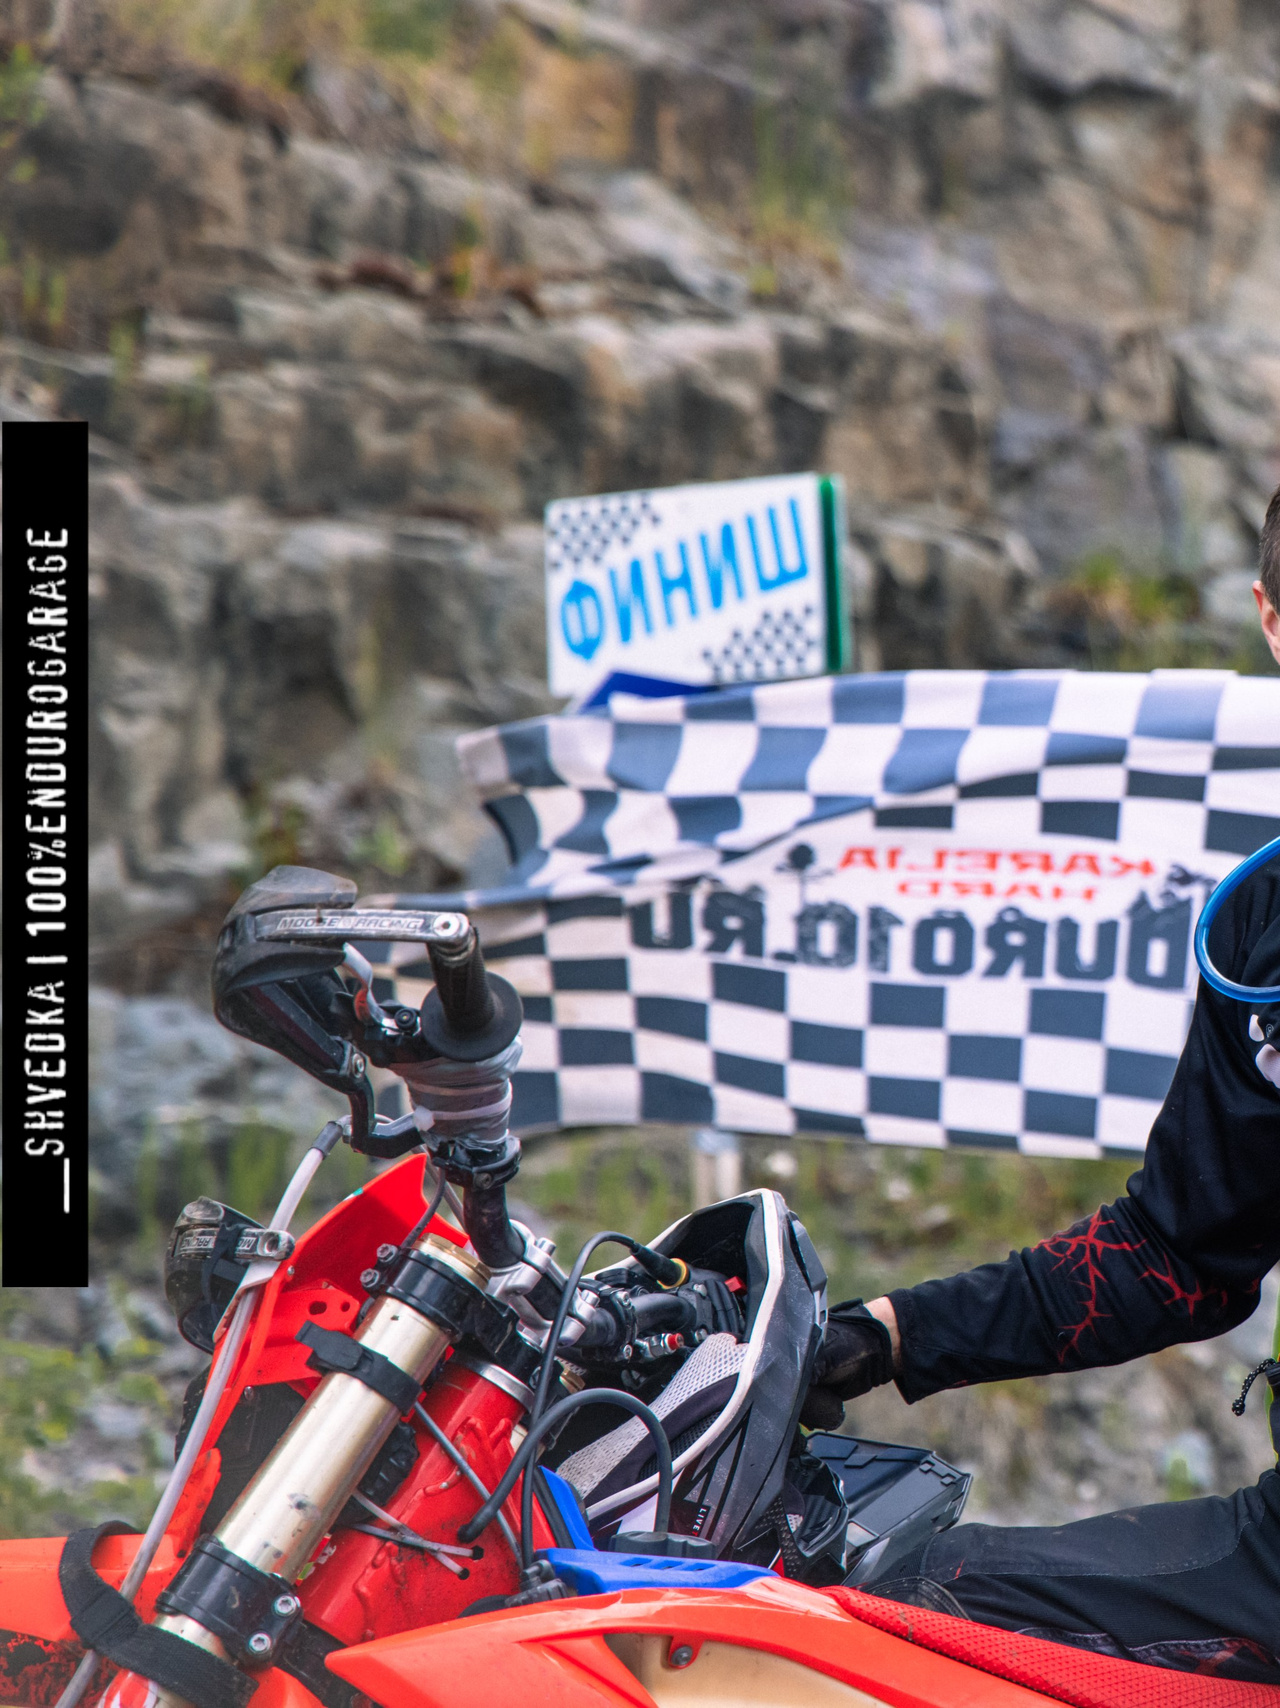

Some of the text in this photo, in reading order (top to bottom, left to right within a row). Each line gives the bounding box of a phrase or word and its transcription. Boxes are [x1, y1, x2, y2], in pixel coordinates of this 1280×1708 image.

[560, 497, 808, 661] ФИНИШ
[280, 917, 421, 930] MOOSE RACING
